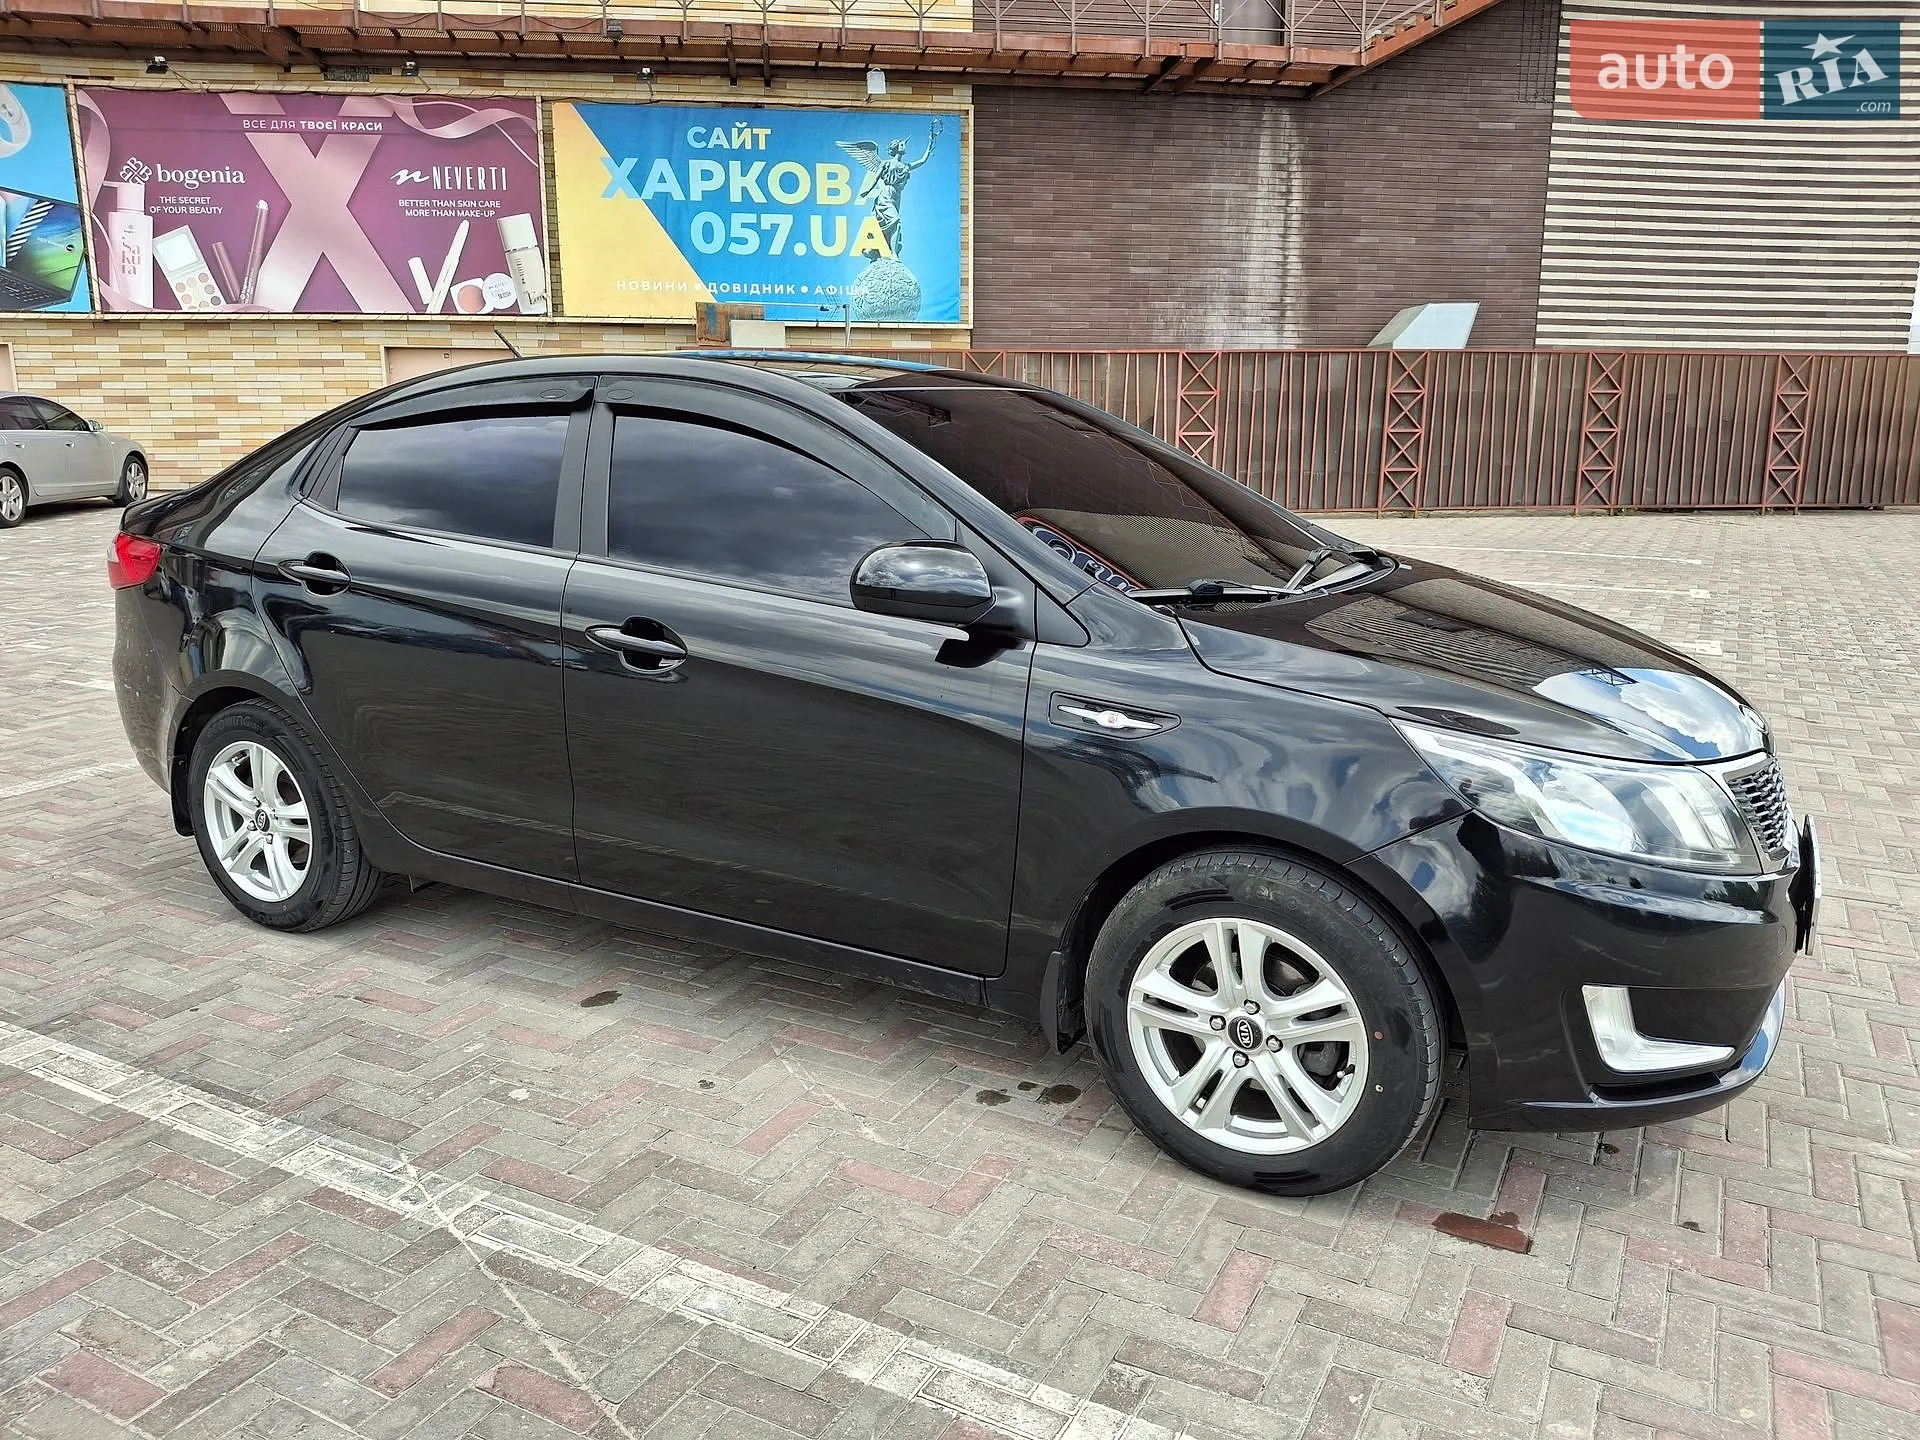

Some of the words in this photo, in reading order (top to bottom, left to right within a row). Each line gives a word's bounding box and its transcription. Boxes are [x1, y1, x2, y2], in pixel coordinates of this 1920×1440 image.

[242, 119, 267, 129] ВСЕ
[270, 120, 296, 131] ДЛЯ
[299, 119, 337, 131] ТВОЄЇ
[341, 121, 383, 132] КРАСИ
[686, 122, 772, 150] САЙТ
[157, 164, 246, 189] bogenia
[432, 166, 508, 191] NEVERTI
[159, 196, 177, 205] THE
[178, 197, 211, 205] SECRET
[398, 199, 430, 208] BETTER
[432, 200, 455, 208] THAN
[457, 200, 476, 208] SKIN
[478, 200, 501, 208] CARE
[149, 206, 162, 214] OF
[163, 206, 187, 214] YOUR
[189, 207, 224, 215] BEAUTY
[405, 209, 430, 217] MORE
[431, 209, 455, 217] THAN
[457, 210, 496, 218] MAKE-UP
[690, 211, 890, 257] 057.UA
[616, 280, 688, 292] НОВИНИ
[706, 282, 796, 296] ДОВІДНИК
